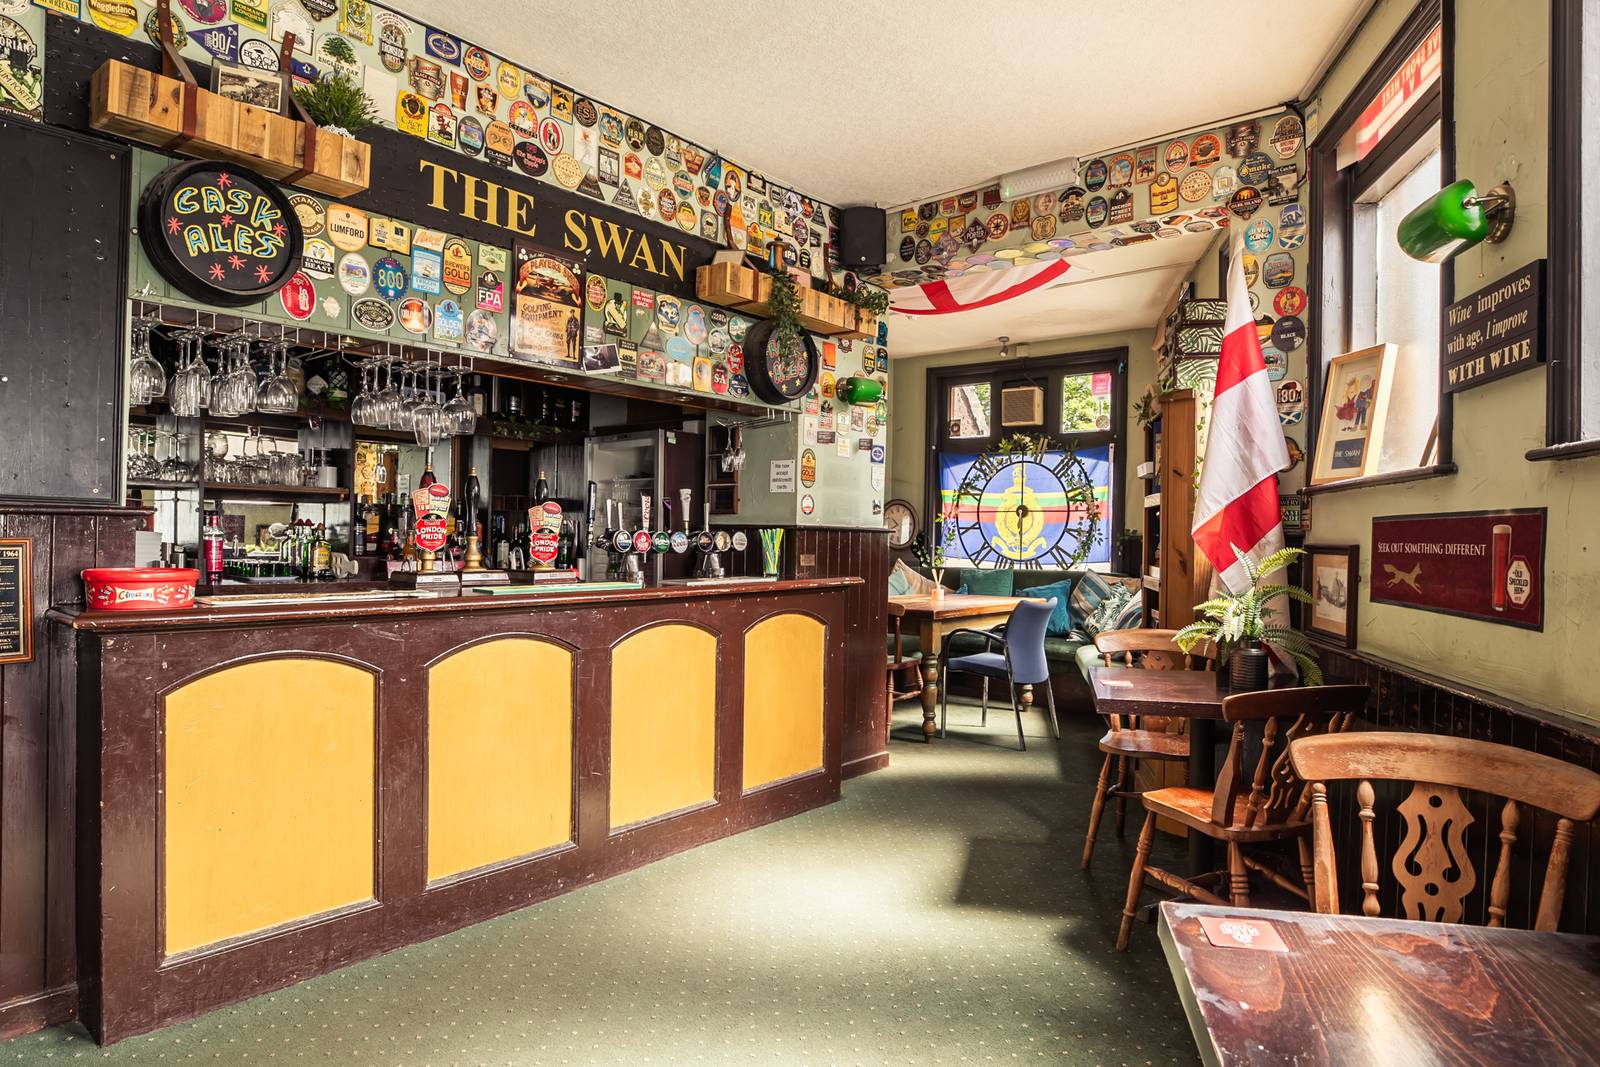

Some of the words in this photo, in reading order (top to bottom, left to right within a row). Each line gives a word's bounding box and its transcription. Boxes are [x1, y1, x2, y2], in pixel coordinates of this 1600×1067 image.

[243, 50, 277, 68] BLACK
[346, 66, 359, 76] OAK
[10, 80, 35, 106] PORTER
[174, 186, 281, 231] CASK
[420, 159, 536, 237] THE
[564, 209, 687, 282] SWAN
[1281, 211, 1303, 226] SRA
[330, 222, 365, 239] LUMFORD
[183, 223, 285, 258] ALES
[304, 261, 333, 273] BEAST
[444, 261, 470, 272] BREWERS
[444, 267, 470, 281] GOLD
[378, 269, 404, 289] 800
[478, 290, 502, 306] FPA
[1448, 304, 1473, 327] Wine
[1477, 274, 1531, 314] improves
[521, 309, 563, 321] EQUIPMENT
[522, 302, 552, 314] GOLFING
[1447, 333, 1465, 355] with
[1466, 329, 1484, 350] age,
[1486, 320, 1491, 340] I
[1492, 309, 1528, 338] improve
[1448, 356, 1485, 386] WITH
[1490, 338, 1531, 371] WINE
[415, 526, 446, 535] LONDON
[530, 540, 560, 548] LONDON
[1378, 541, 1391, 553] SEEK
[1391, 542, 1404, 553] OUT
[1404, 542, 1444, 555] SOMETHING
[1445, 543, 1487, 557] DIFFERENT
